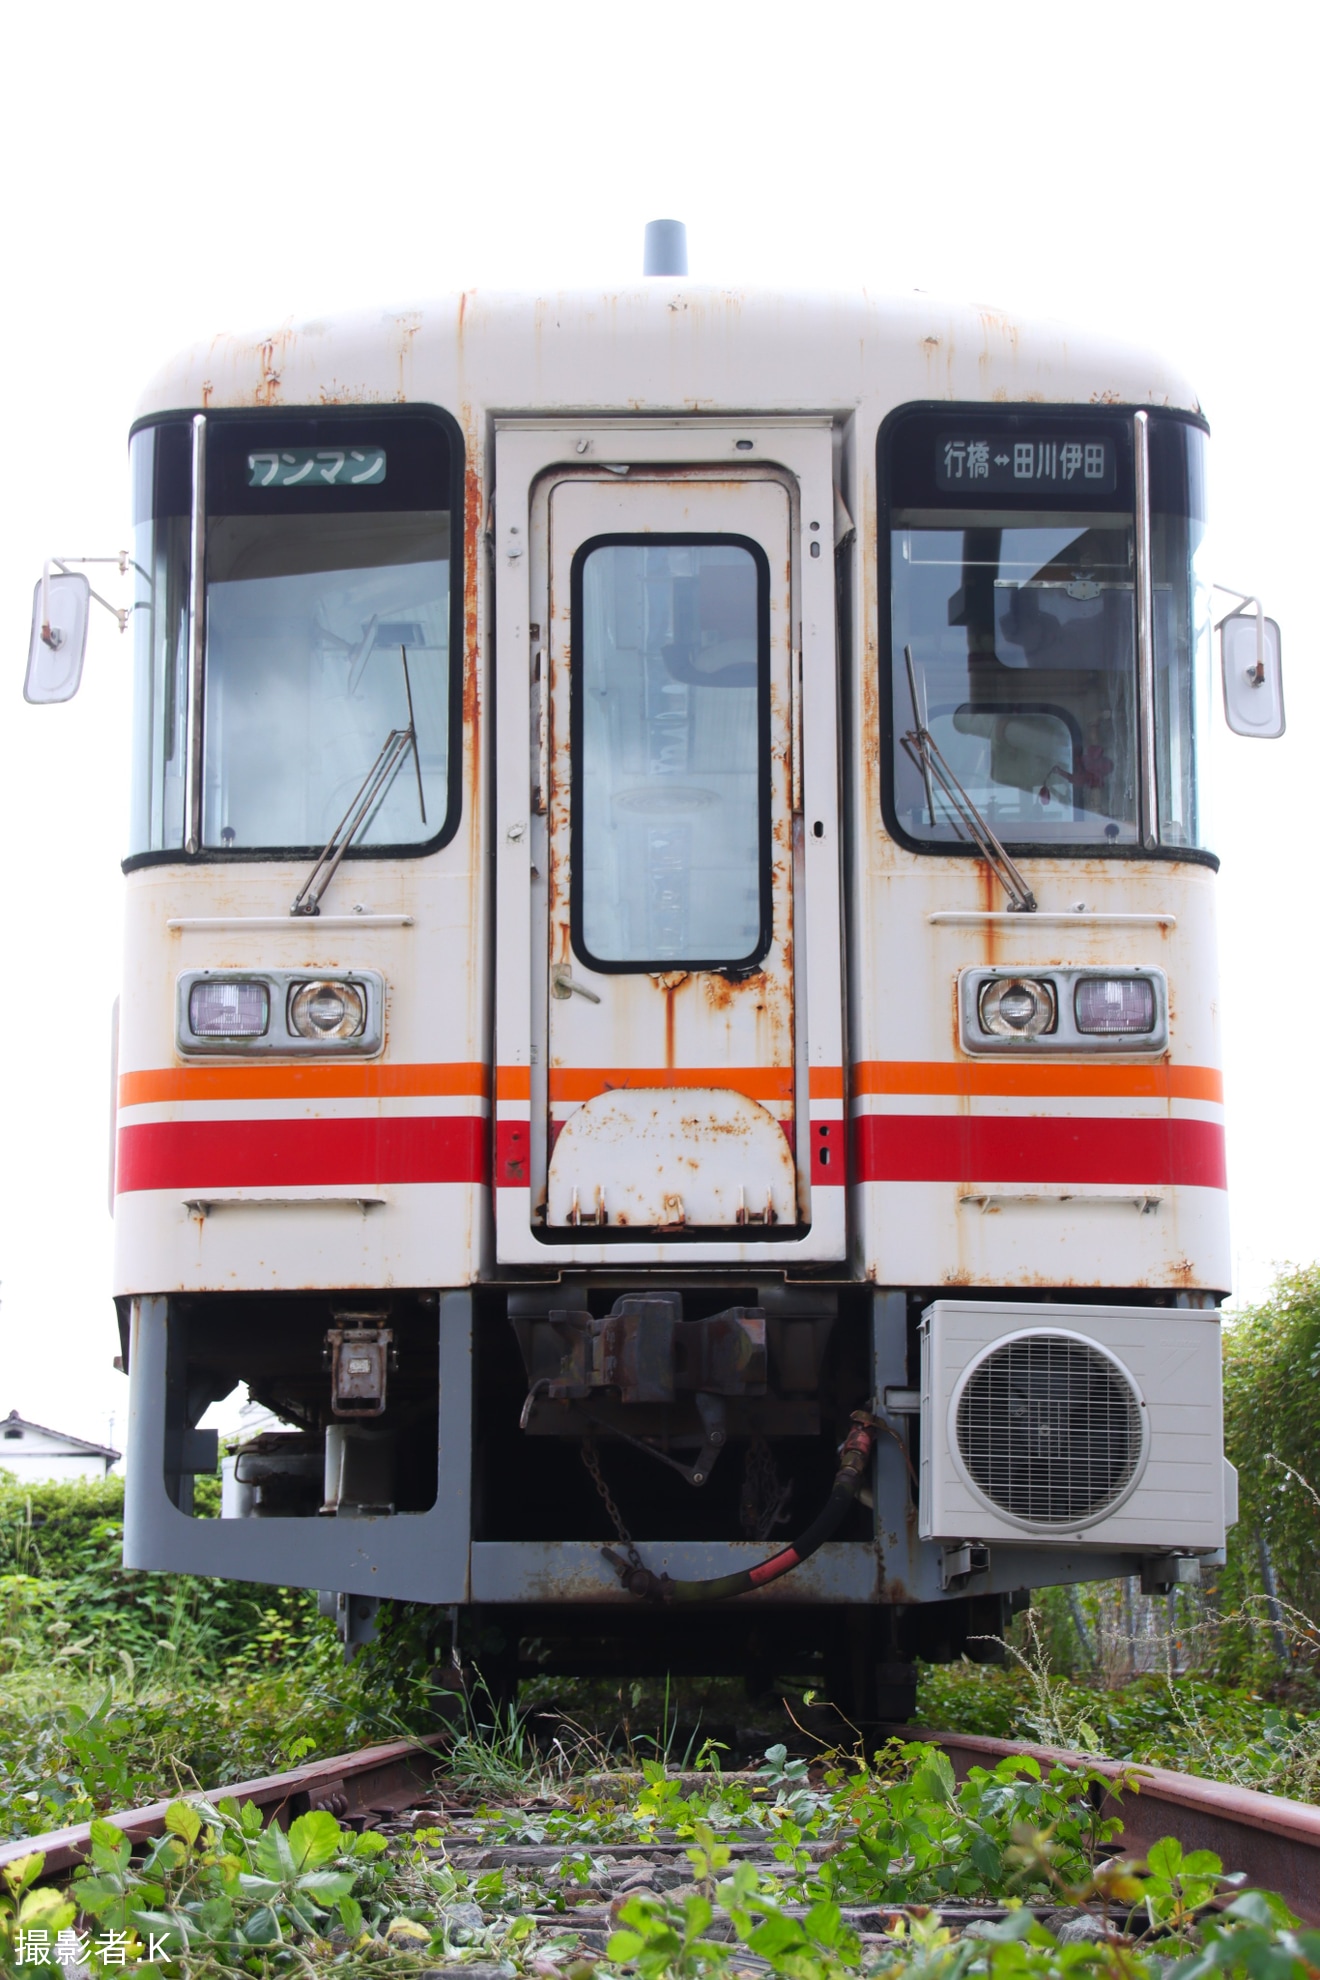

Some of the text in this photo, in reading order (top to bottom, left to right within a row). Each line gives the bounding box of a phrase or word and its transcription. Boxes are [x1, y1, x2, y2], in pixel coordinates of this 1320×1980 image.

[248, 450, 384, 486] ワンマン
[944, 440, 1105, 480] 行橋 田川伊田
